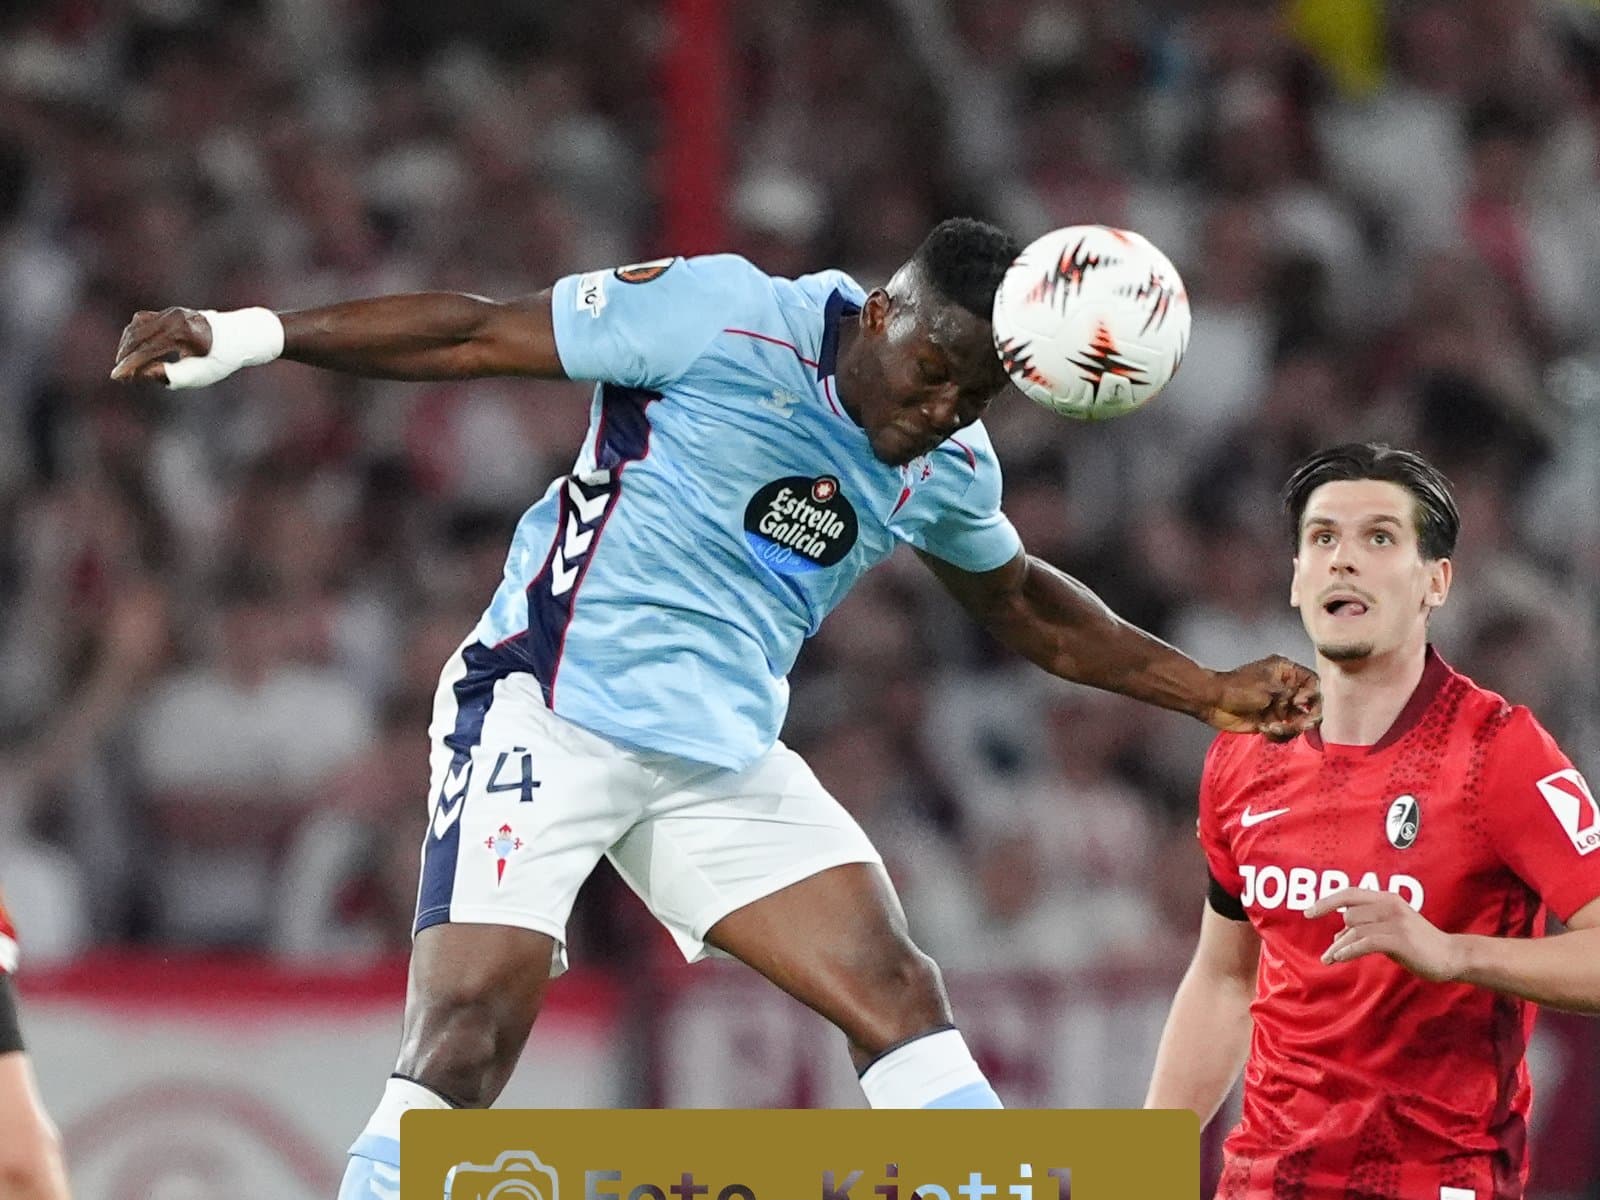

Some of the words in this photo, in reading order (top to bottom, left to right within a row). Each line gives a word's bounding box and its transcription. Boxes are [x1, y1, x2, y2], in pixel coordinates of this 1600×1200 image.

[759, 510, 827, 558] Galicia
[768, 487, 845, 539] Estrella
[486, 745, 542, 802] 4
